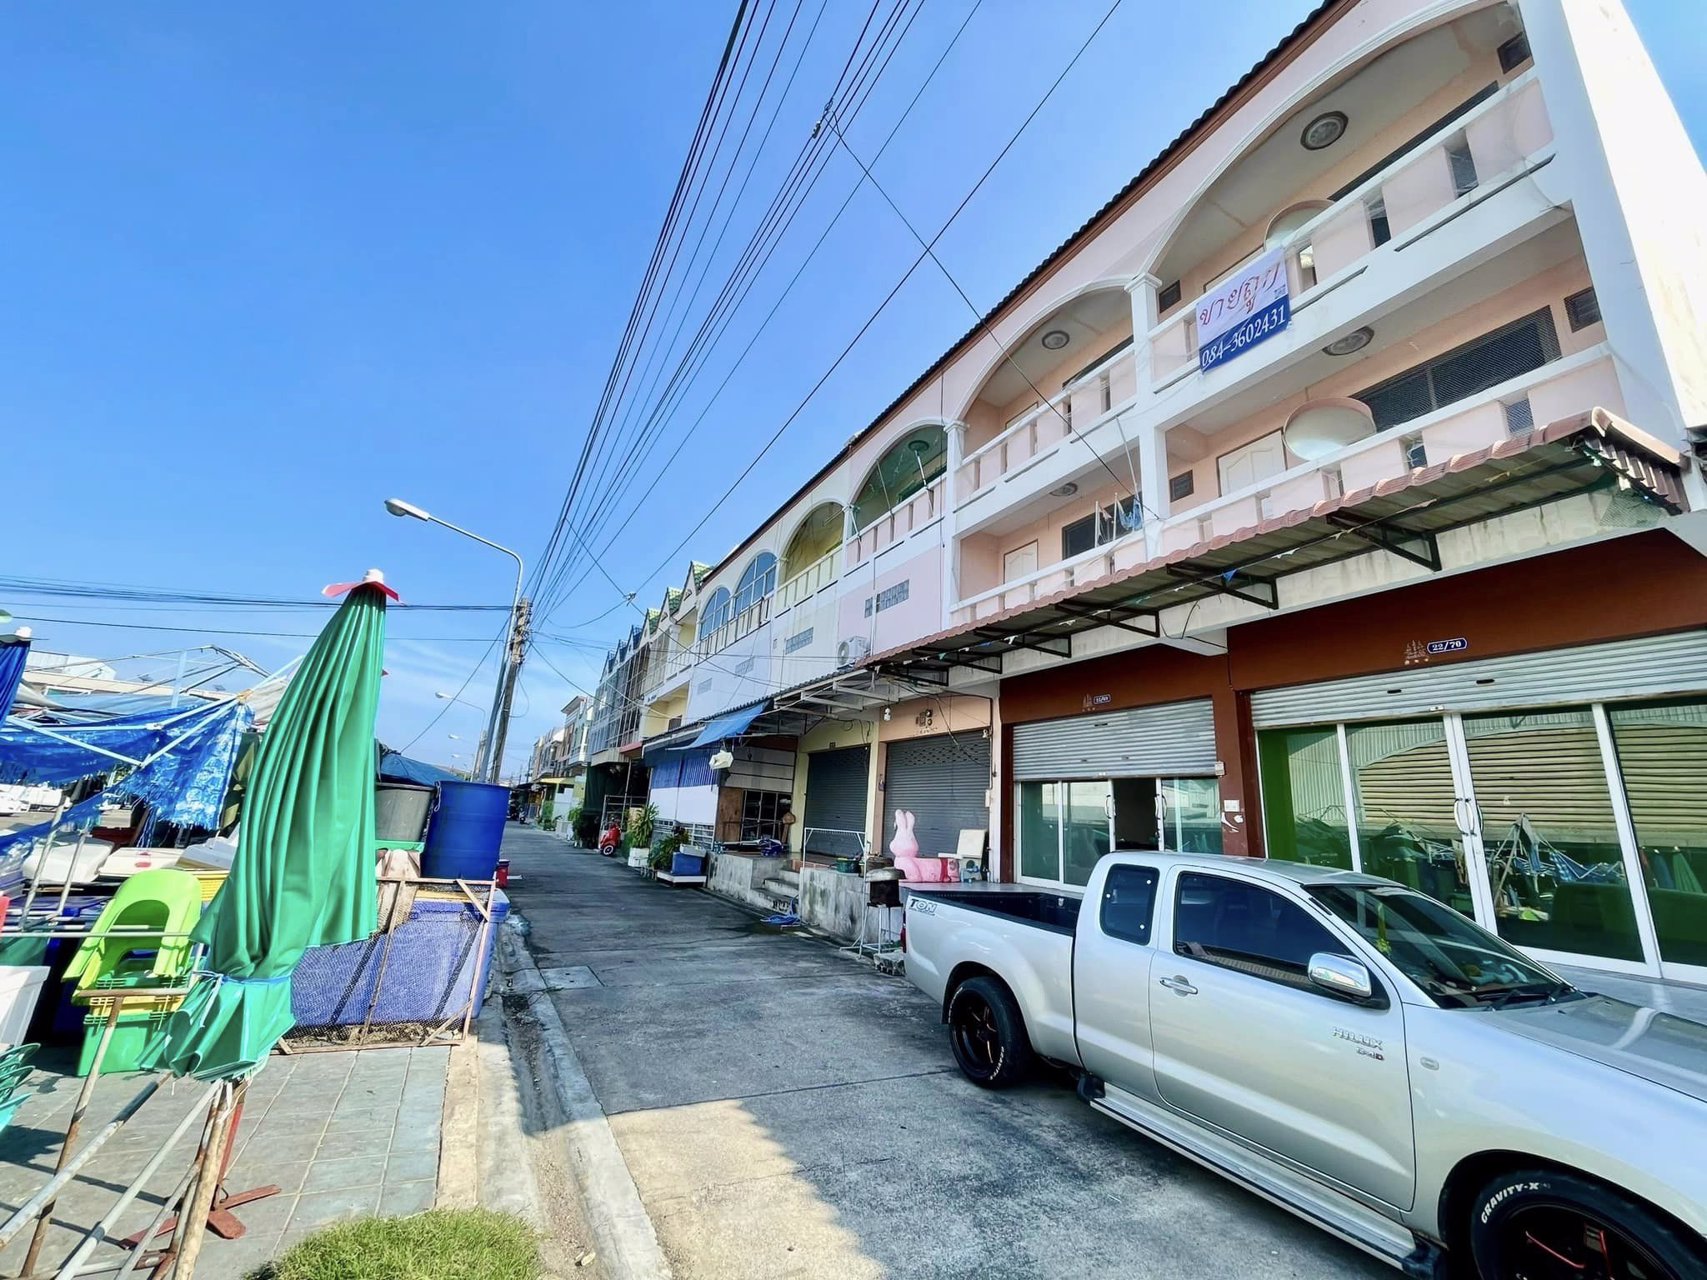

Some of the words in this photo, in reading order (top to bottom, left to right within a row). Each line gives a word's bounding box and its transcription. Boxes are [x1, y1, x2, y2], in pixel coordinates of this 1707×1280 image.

[1201, 305, 1286, 367] 084-3602431
[1432, 640, 1462, 651] 22/70
[1332, 1026, 1383, 1051] HILUX
[1480, 1182, 1540, 1224] GRAVITY-X
